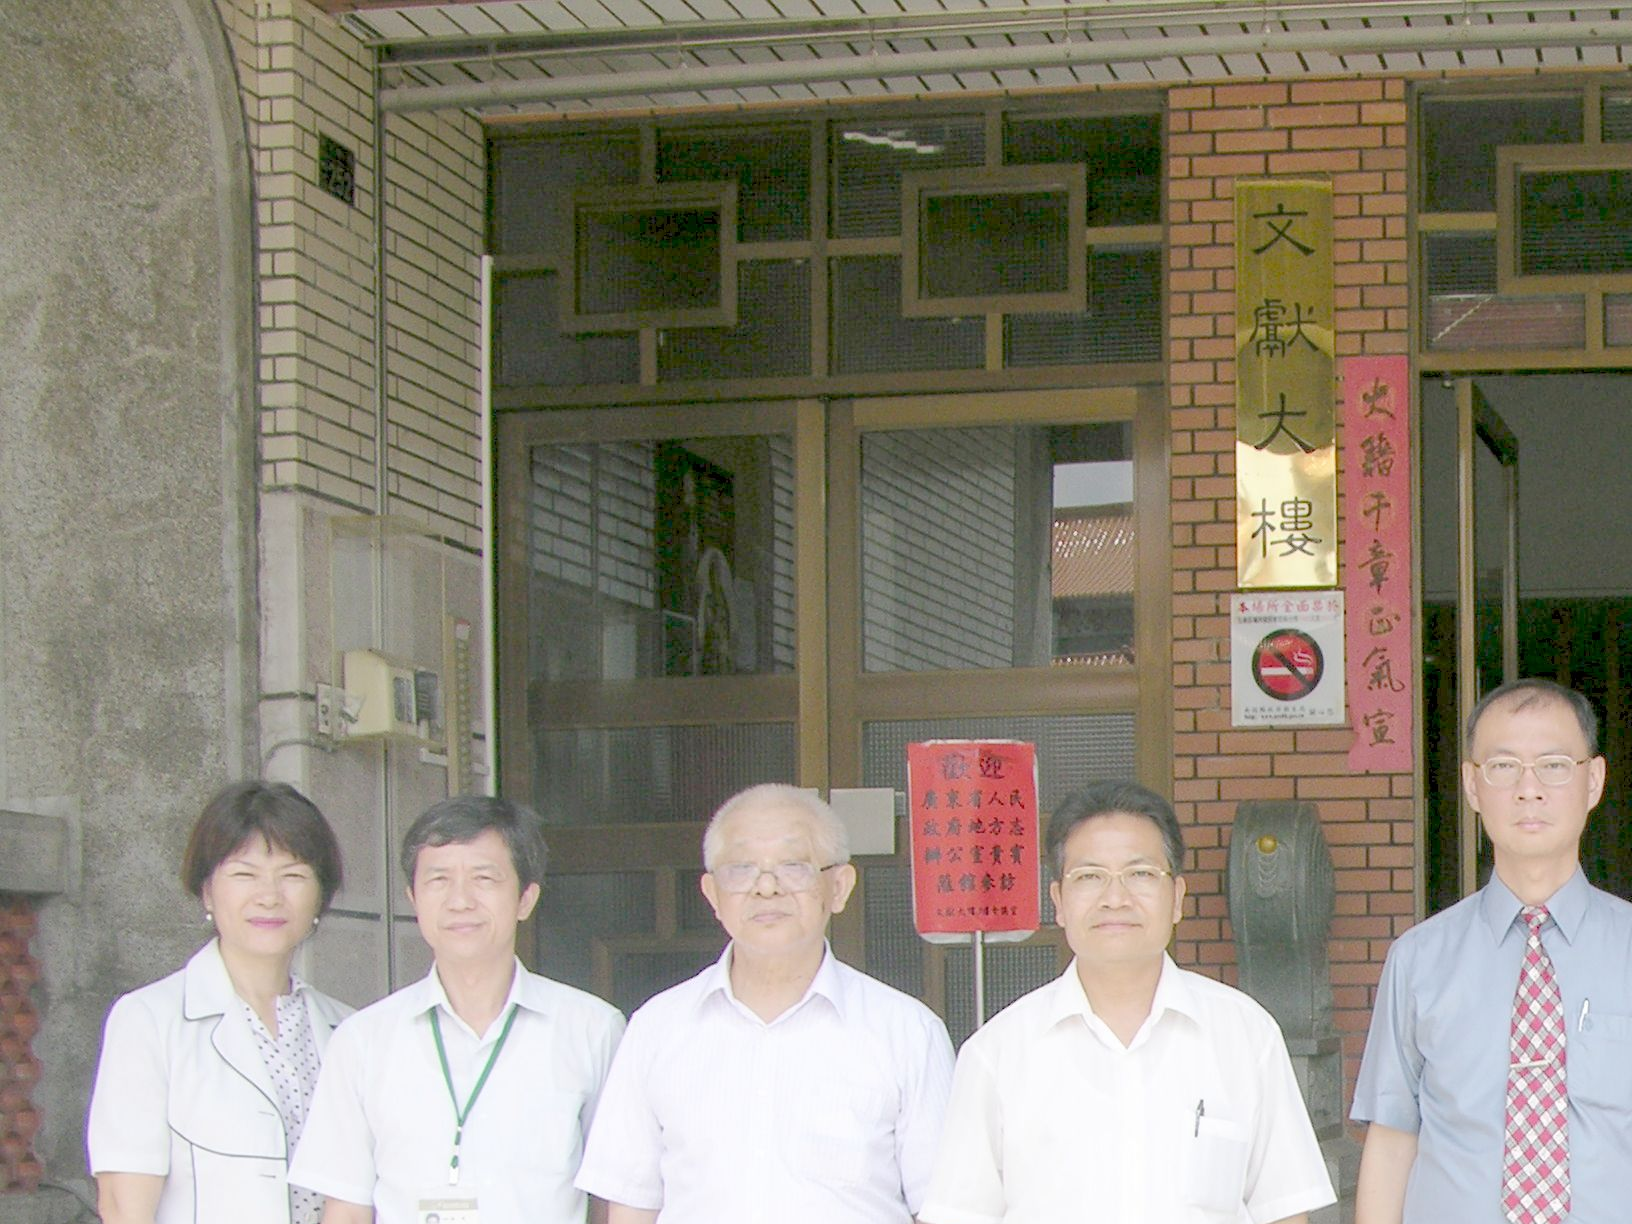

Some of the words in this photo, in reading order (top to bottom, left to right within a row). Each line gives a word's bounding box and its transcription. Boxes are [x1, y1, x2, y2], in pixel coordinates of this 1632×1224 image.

[1249, 203, 1323, 559] 文獻大樓
[941, 753, 1005, 779] 歡迎
[922, 789, 1025, 810] 廣東省人民
[923, 817, 1025, 836] 政府地方志
[925, 844, 1025, 866] 辦公室貴賓
